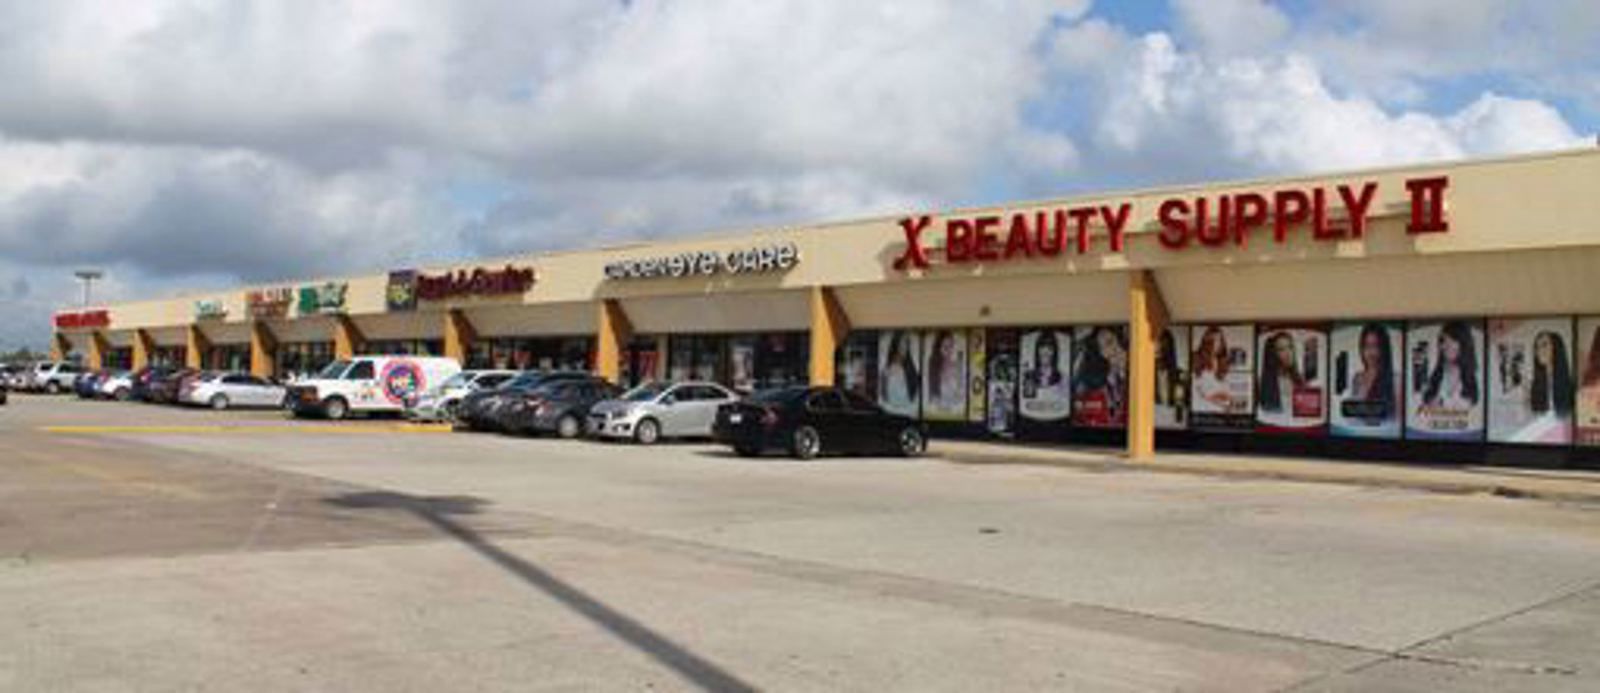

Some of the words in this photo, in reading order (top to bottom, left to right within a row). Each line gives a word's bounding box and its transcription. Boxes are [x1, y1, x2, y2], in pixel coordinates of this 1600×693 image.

[893, 214, 932, 270] X
[946, 202, 1132, 262] BEAUTY
[1157, 182, 1378, 251] SUPPLY
[1405, 176, 1449, 235] II
